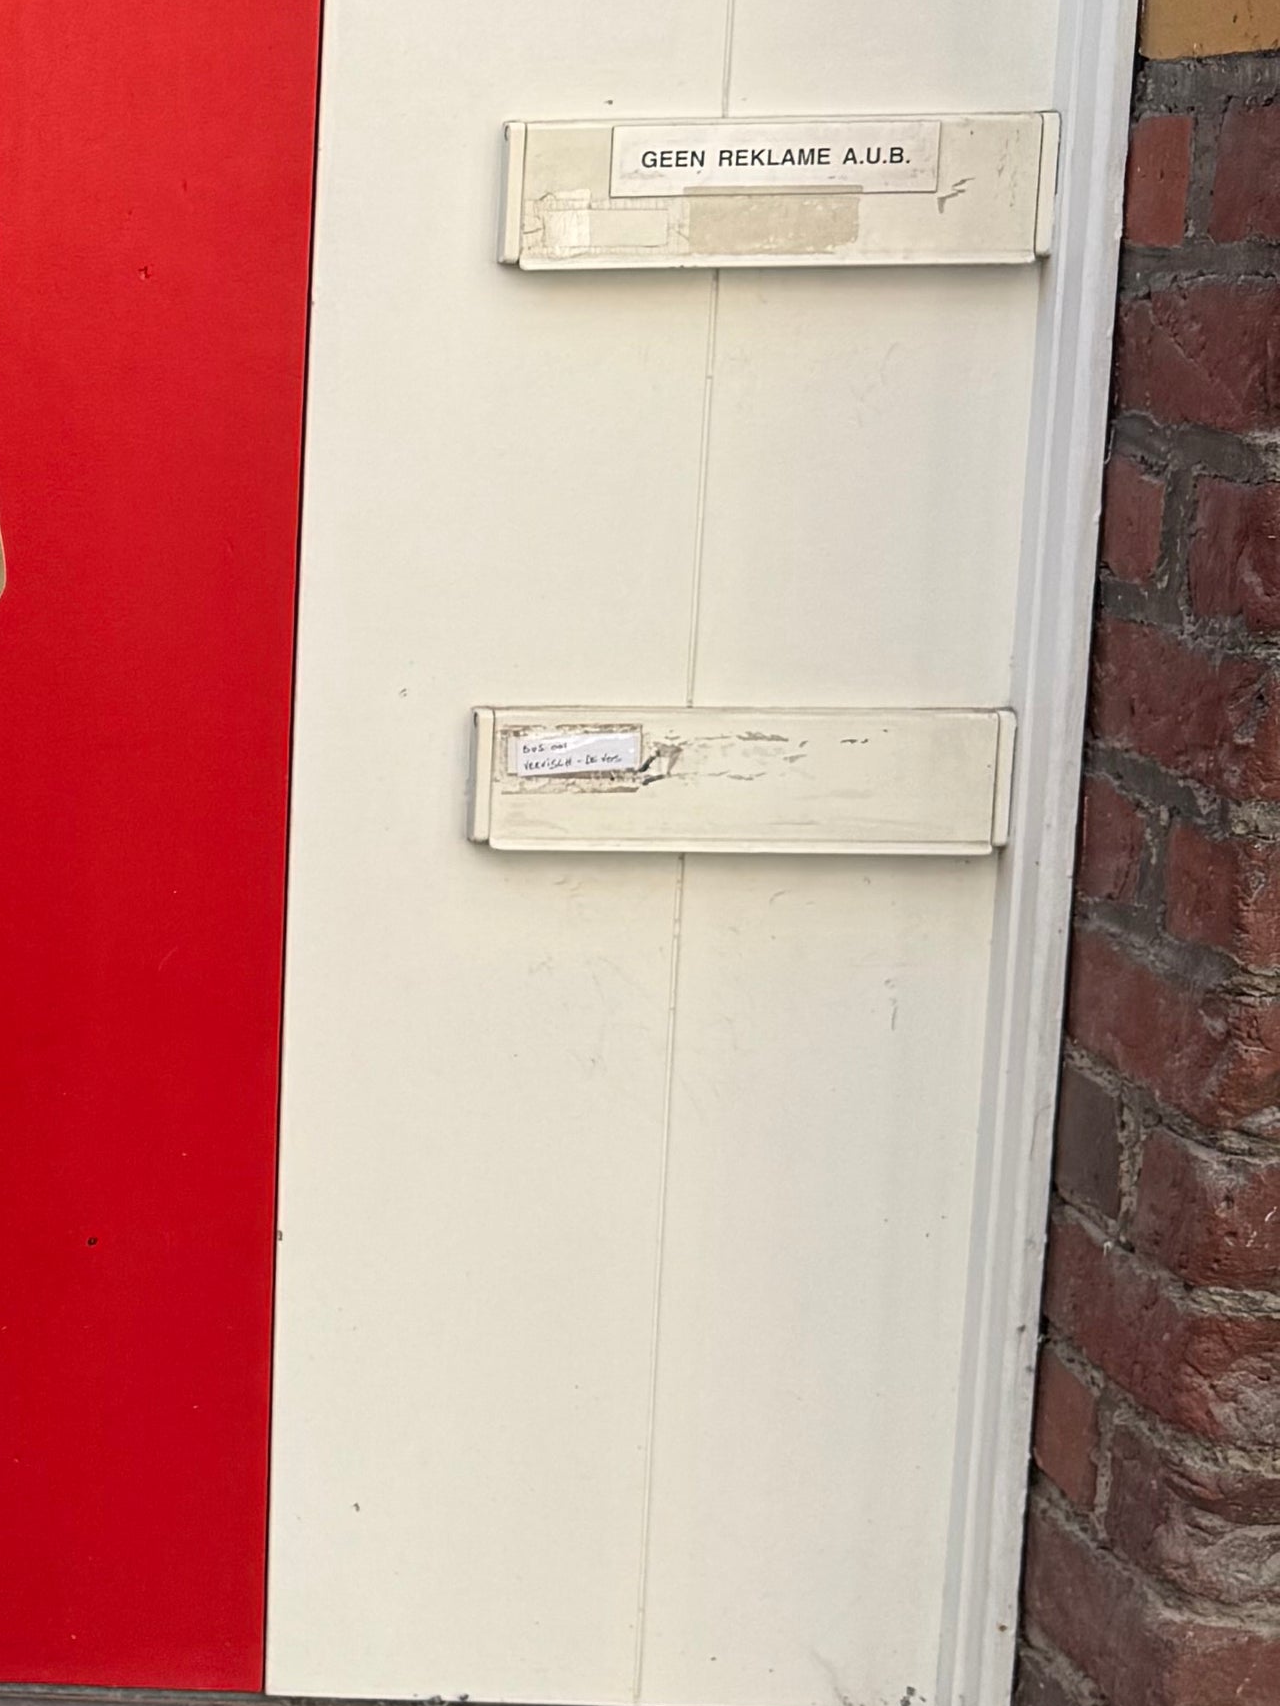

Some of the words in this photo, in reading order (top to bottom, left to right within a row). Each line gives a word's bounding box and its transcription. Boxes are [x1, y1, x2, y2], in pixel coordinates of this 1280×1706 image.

[641, 150, 706, 168] GEEN
[718, 147, 832, 167] REKLAME
[842, 146, 911, 165] A.U.B.
